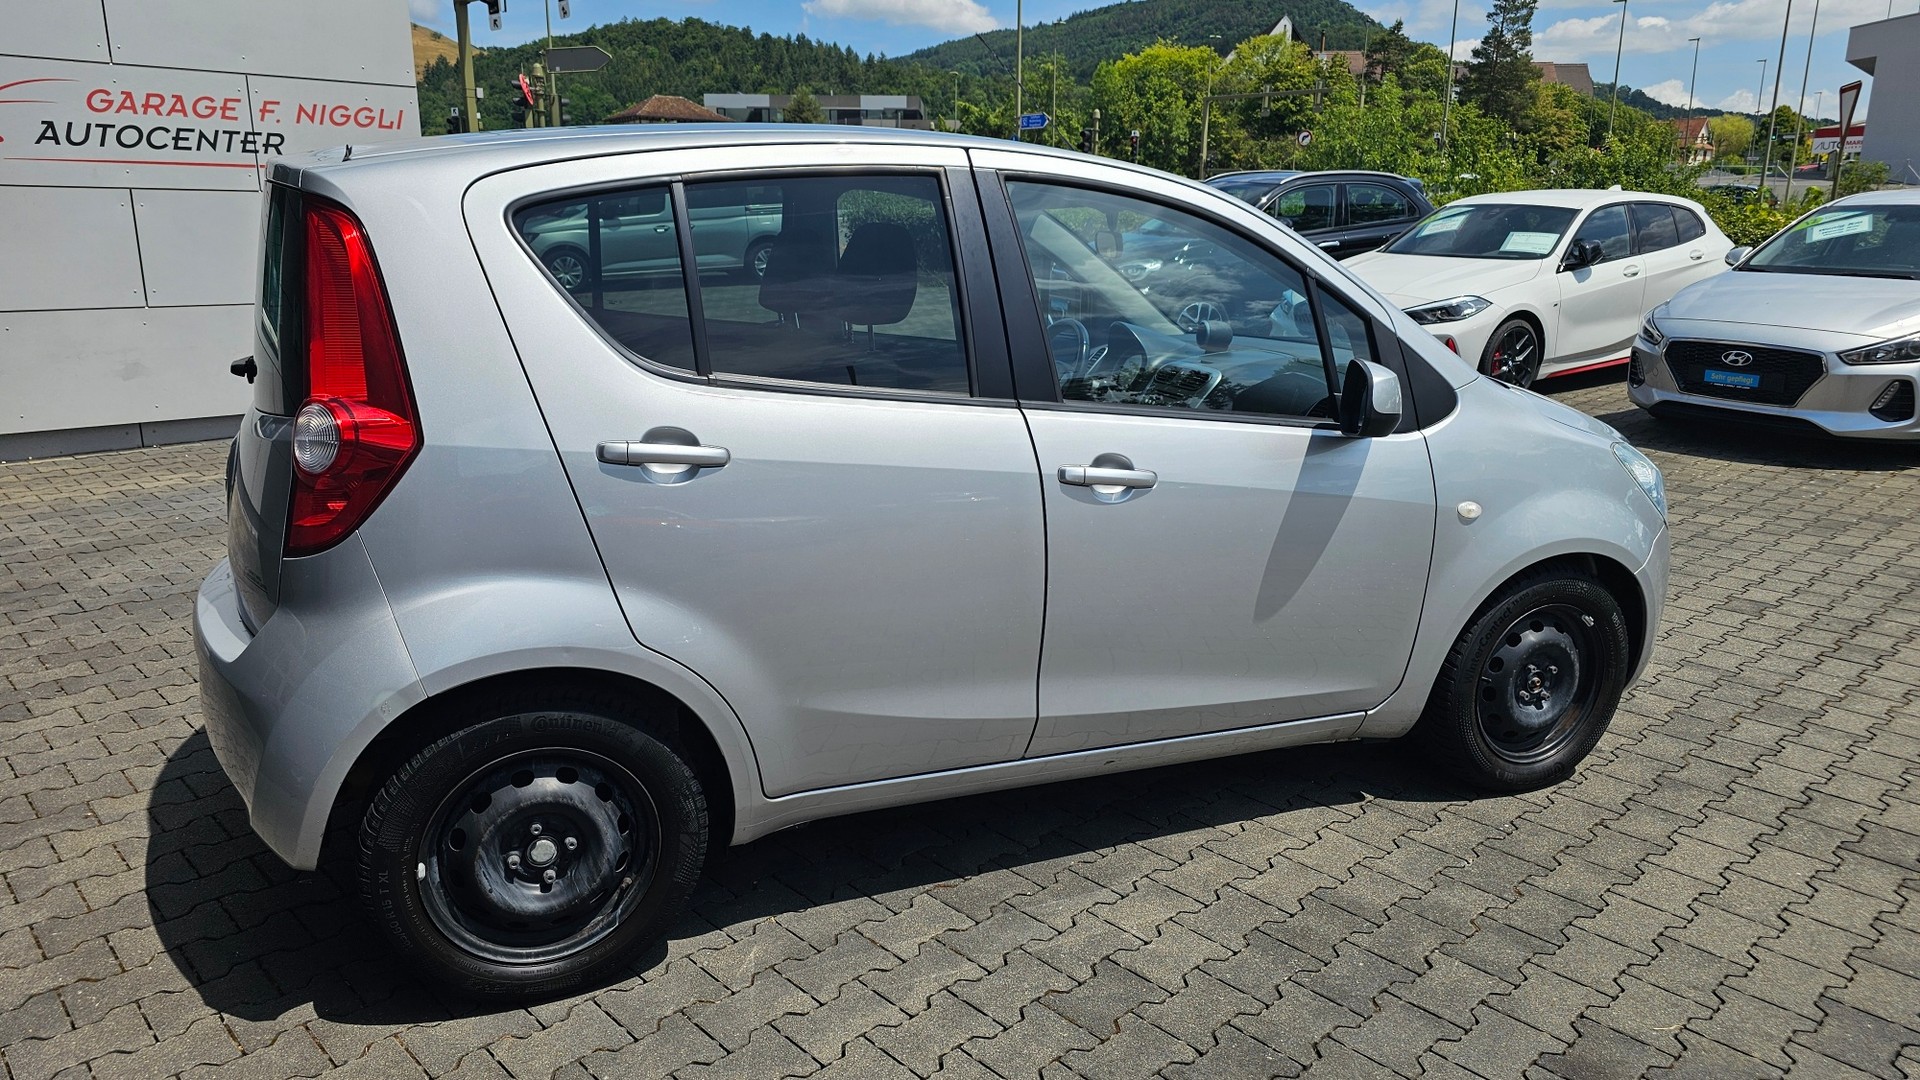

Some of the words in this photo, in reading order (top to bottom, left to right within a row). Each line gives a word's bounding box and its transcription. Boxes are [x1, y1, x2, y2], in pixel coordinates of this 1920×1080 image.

[86, 88, 242, 122] GARAGE
[259, 100, 281, 124] F.
[296, 103, 404, 130] NIGGLI
[34, 120, 286, 156] AUTOCENTER
